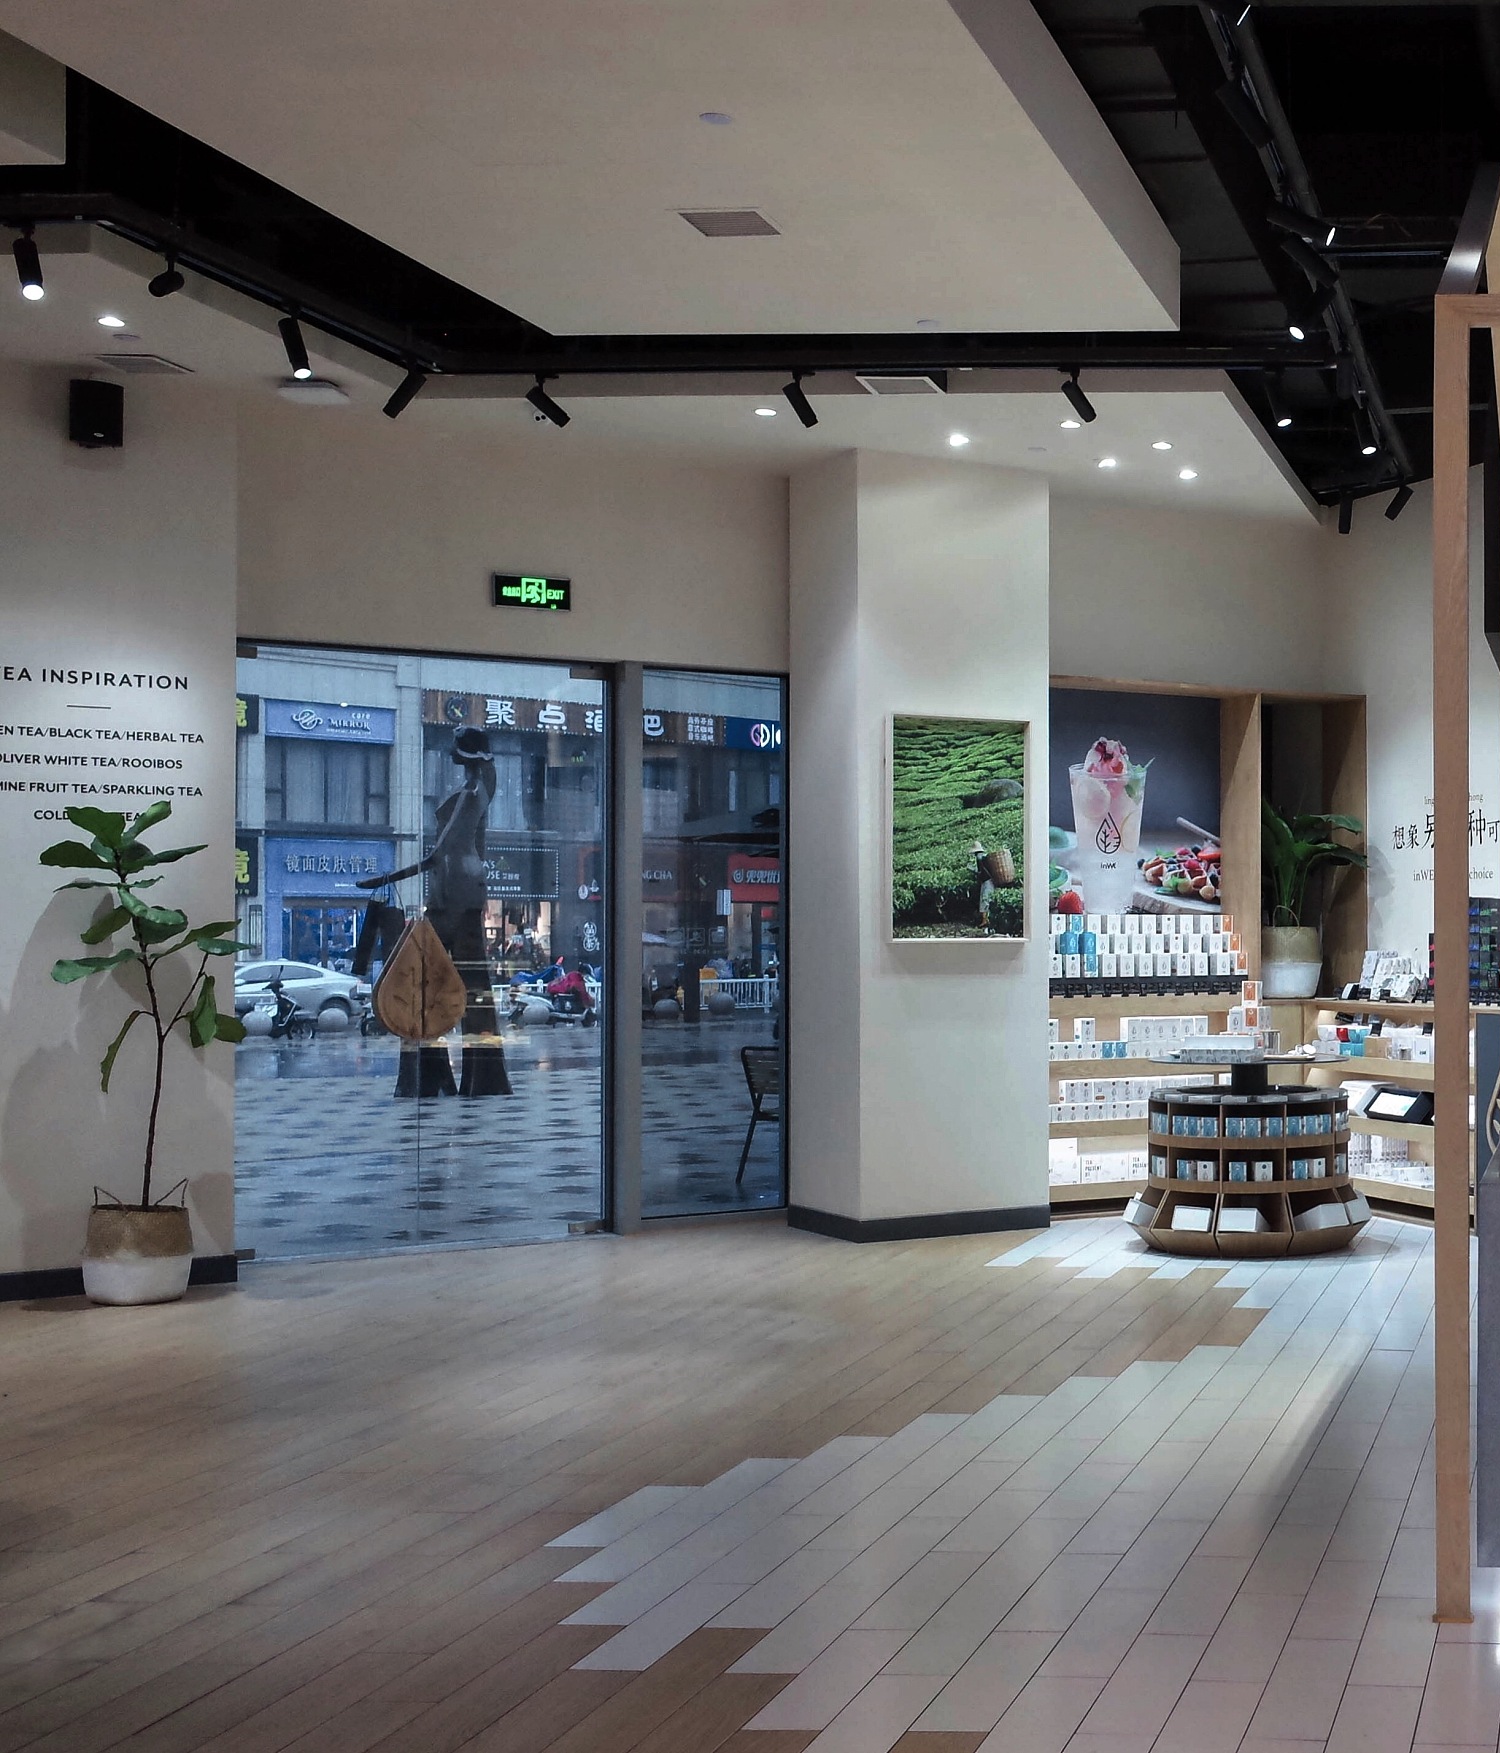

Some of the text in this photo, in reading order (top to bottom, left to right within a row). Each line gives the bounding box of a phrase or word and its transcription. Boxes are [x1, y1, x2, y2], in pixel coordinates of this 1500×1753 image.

[546, 589, 565, 600] EXIT
[0, 666, 188, 690] EA INSPIRATION
[351, 712, 371, 720] care
[17, 726, 93, 740] TEA/BLACK
[95, 729, 177, 743] TEA/HERBAL
[179, 733, 204, 744] TEA
[44, 755, 88, 767] WHITE
[91, 757, 183, 770] TEA/ROOIBOS
[29, 782, 69, 794] FRUIT
[72, 783, 175, 797] TEA/SPARKLING
[178, 786, 203, 797] TEA
[120, 812, 144, 822] EA
[285, 854, 379, 874] 镜面皮肤管理
